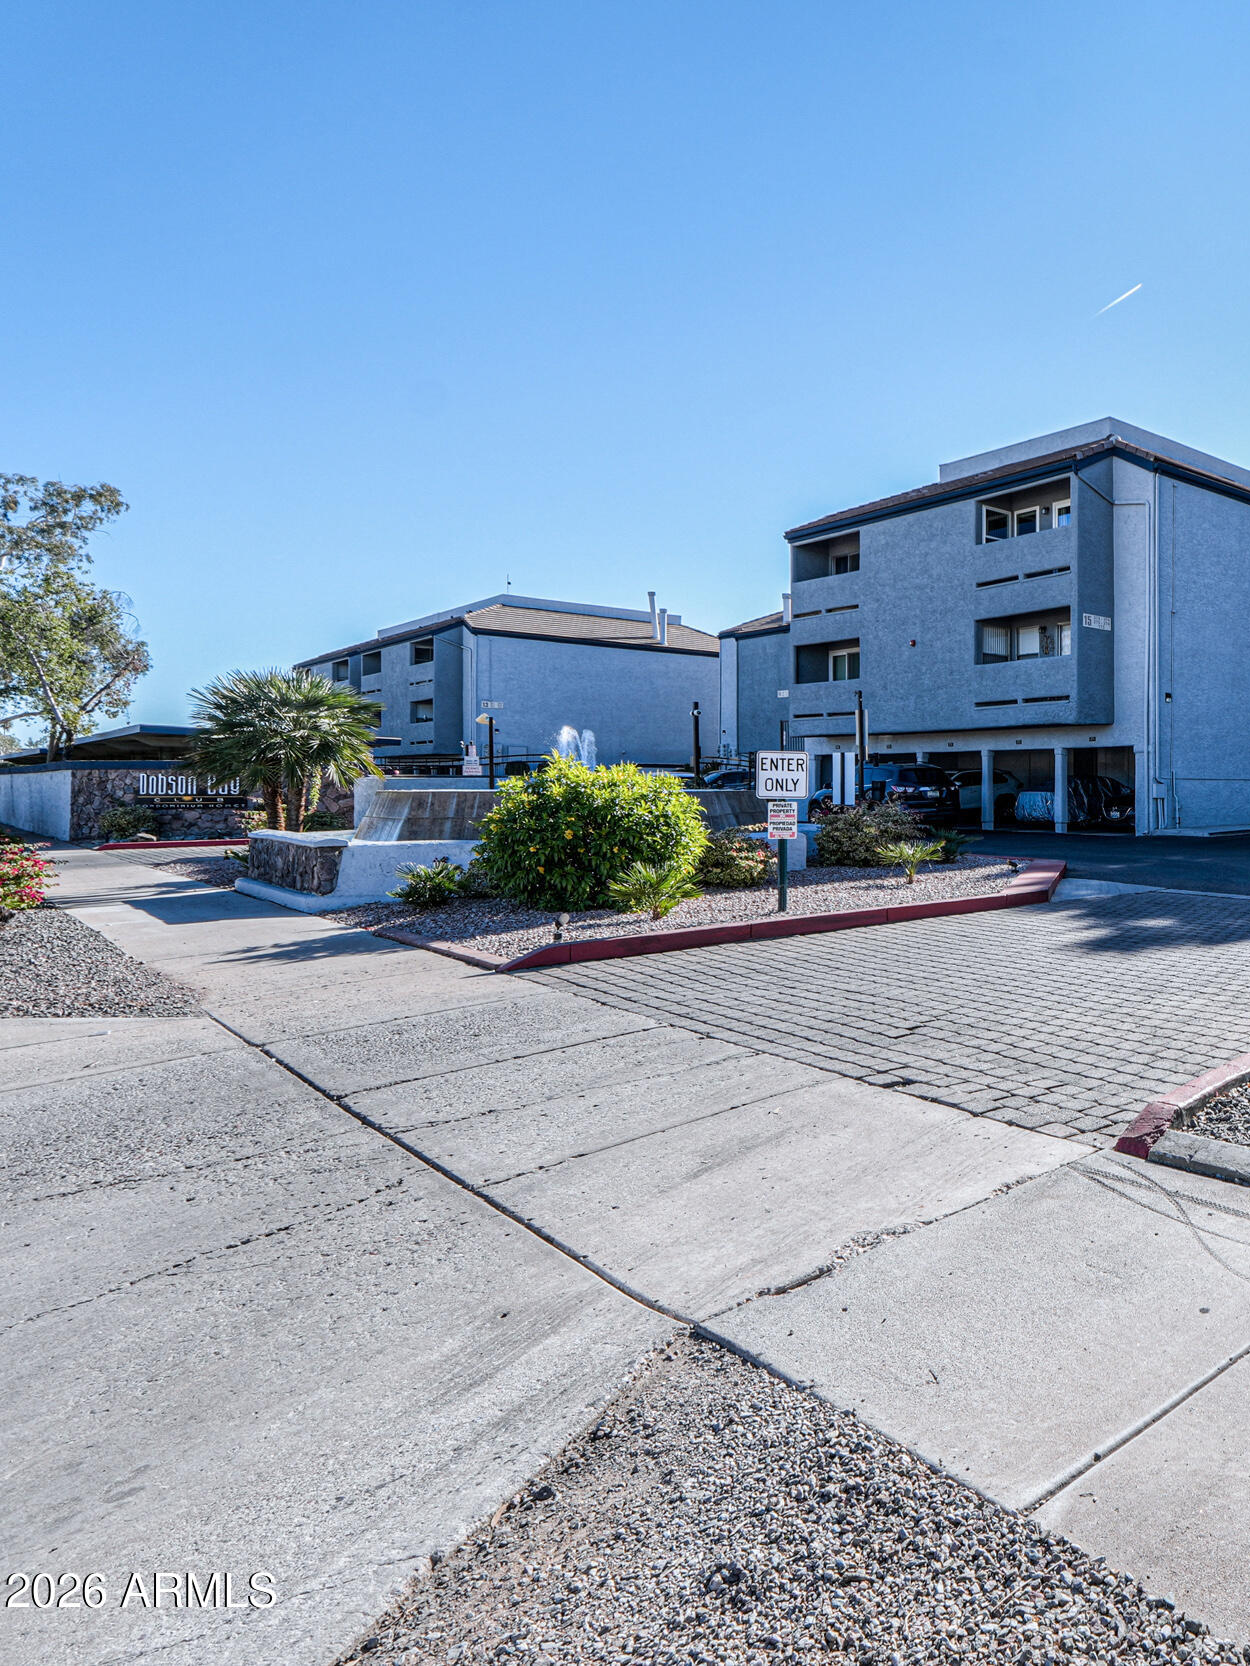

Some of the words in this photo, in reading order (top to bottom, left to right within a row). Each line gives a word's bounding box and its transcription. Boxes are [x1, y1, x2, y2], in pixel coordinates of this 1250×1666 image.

[1084, 615, 1092, 626] 15
[761, 757, 804, 771] ENTER
[139, 773, 197, 795] Dobson
[765, 778, 799, 792] ONLY
